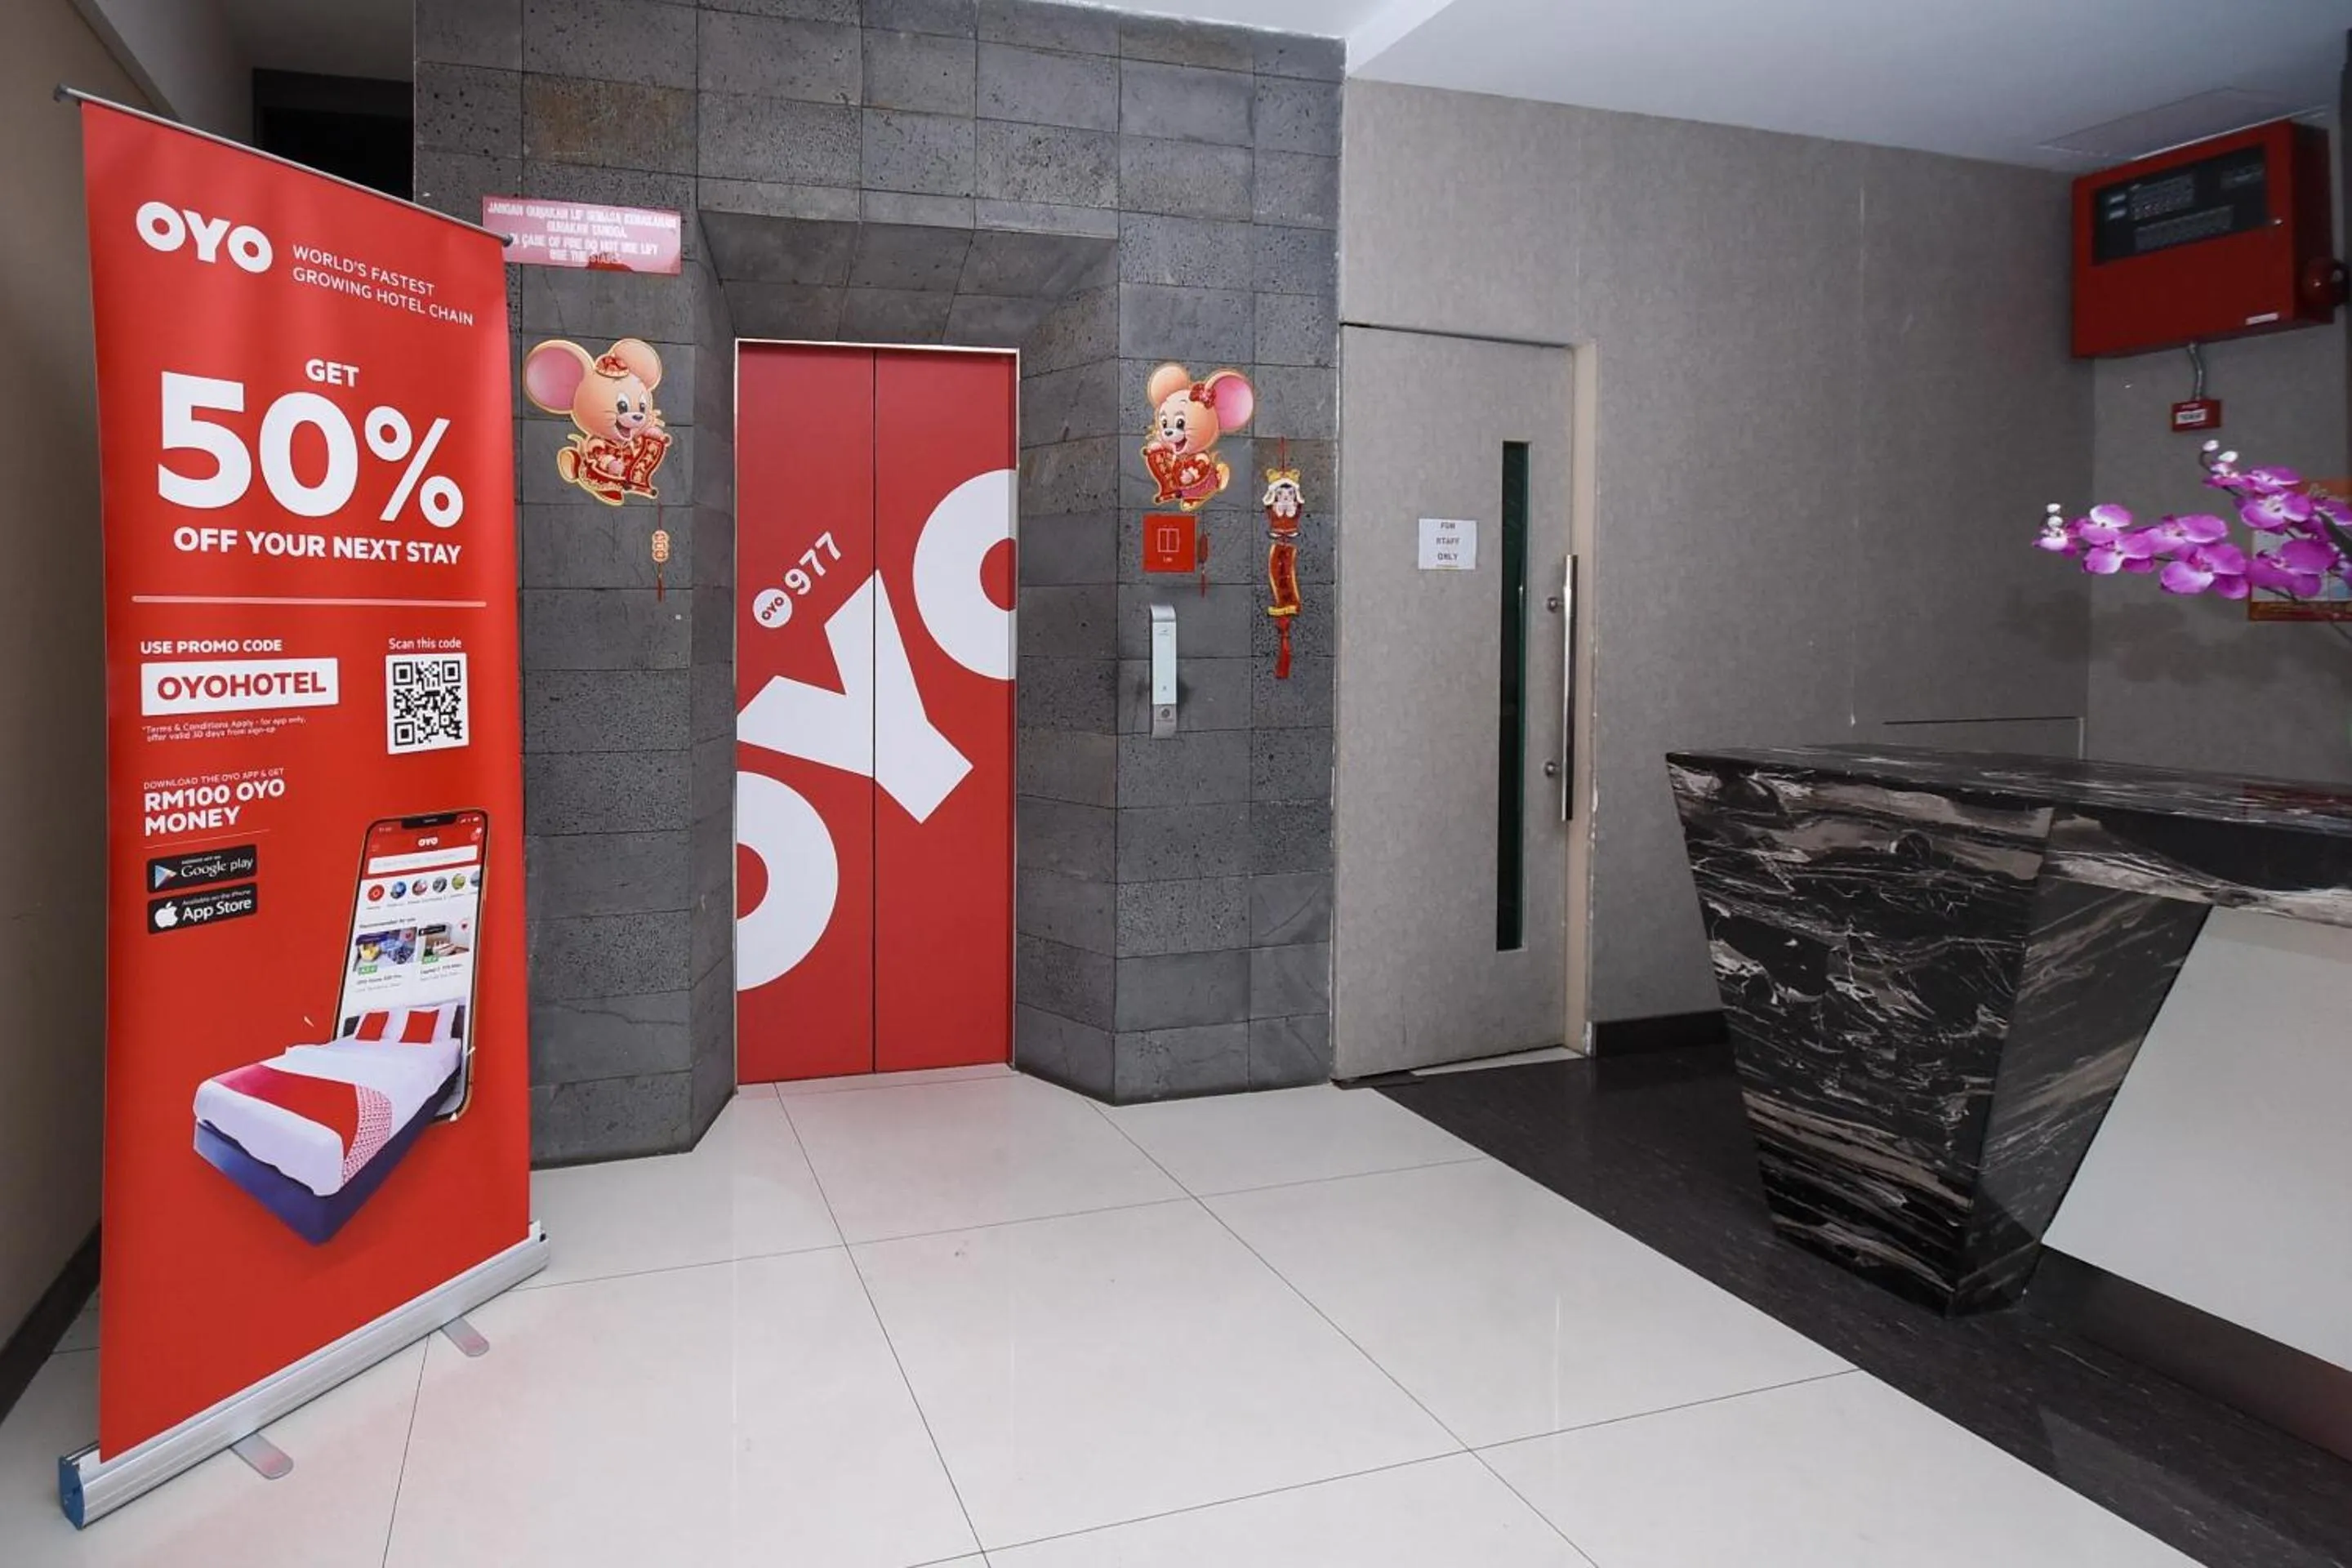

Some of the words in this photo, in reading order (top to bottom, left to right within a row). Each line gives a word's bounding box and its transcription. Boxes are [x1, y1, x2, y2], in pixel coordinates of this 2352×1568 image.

[136, 202, 273, 274] OYO
[292, 244, 367, 278] WORLD'S
[372, 267, 434, 296] FASTEST
[292, 267, 372, 299] GROWING
[377, 289, 425, 314] HOTEL
[429, 304, 474, 327] CHAIN
[305, 359, 359, 388] GET
[158, 371, 465, 528] 50%
[173, 527, 238, 553] OFF
[247, 531, 327, 559] YOUR
[333, 537, 402, 561] NEXT
[407, 541, 461, 565] STAY
[761, 596, 784, 621] OYO
[784, 531, 842, 595] 977
[140, 640, 172, 655] USE
[176, 639, 240, 654] PROMO
[243, 639, 283, 652] CODE
[388, 637, 413, 650] Scan
[416, 637, 434, 650] this
[436, 637, 462, 649] code
[157, 671, 327, 701] OYOHOTEL
[182, 721, 229, 732] Conditions
[231, 719, 254, 728] Apply
[143, 777, 198, 791] DOWNLOAD
[201, 774, 220, 784] THE
[221, 772, 240, 782] OYO
[242, 770, 260, 779] APP
[267, 767, 285, 777] GET
[144, 783, 230, 812] RM100
[236, 778, 286, 802] OYO
[144, 806, 241, 836] MONEY
[418, 837, 439, 846] OYO
[180, 860, 228, 878] Google
[229, 858, 253, 872] play
[182, 906, 214, 923] App
[216, 899, 252, 915] Store
